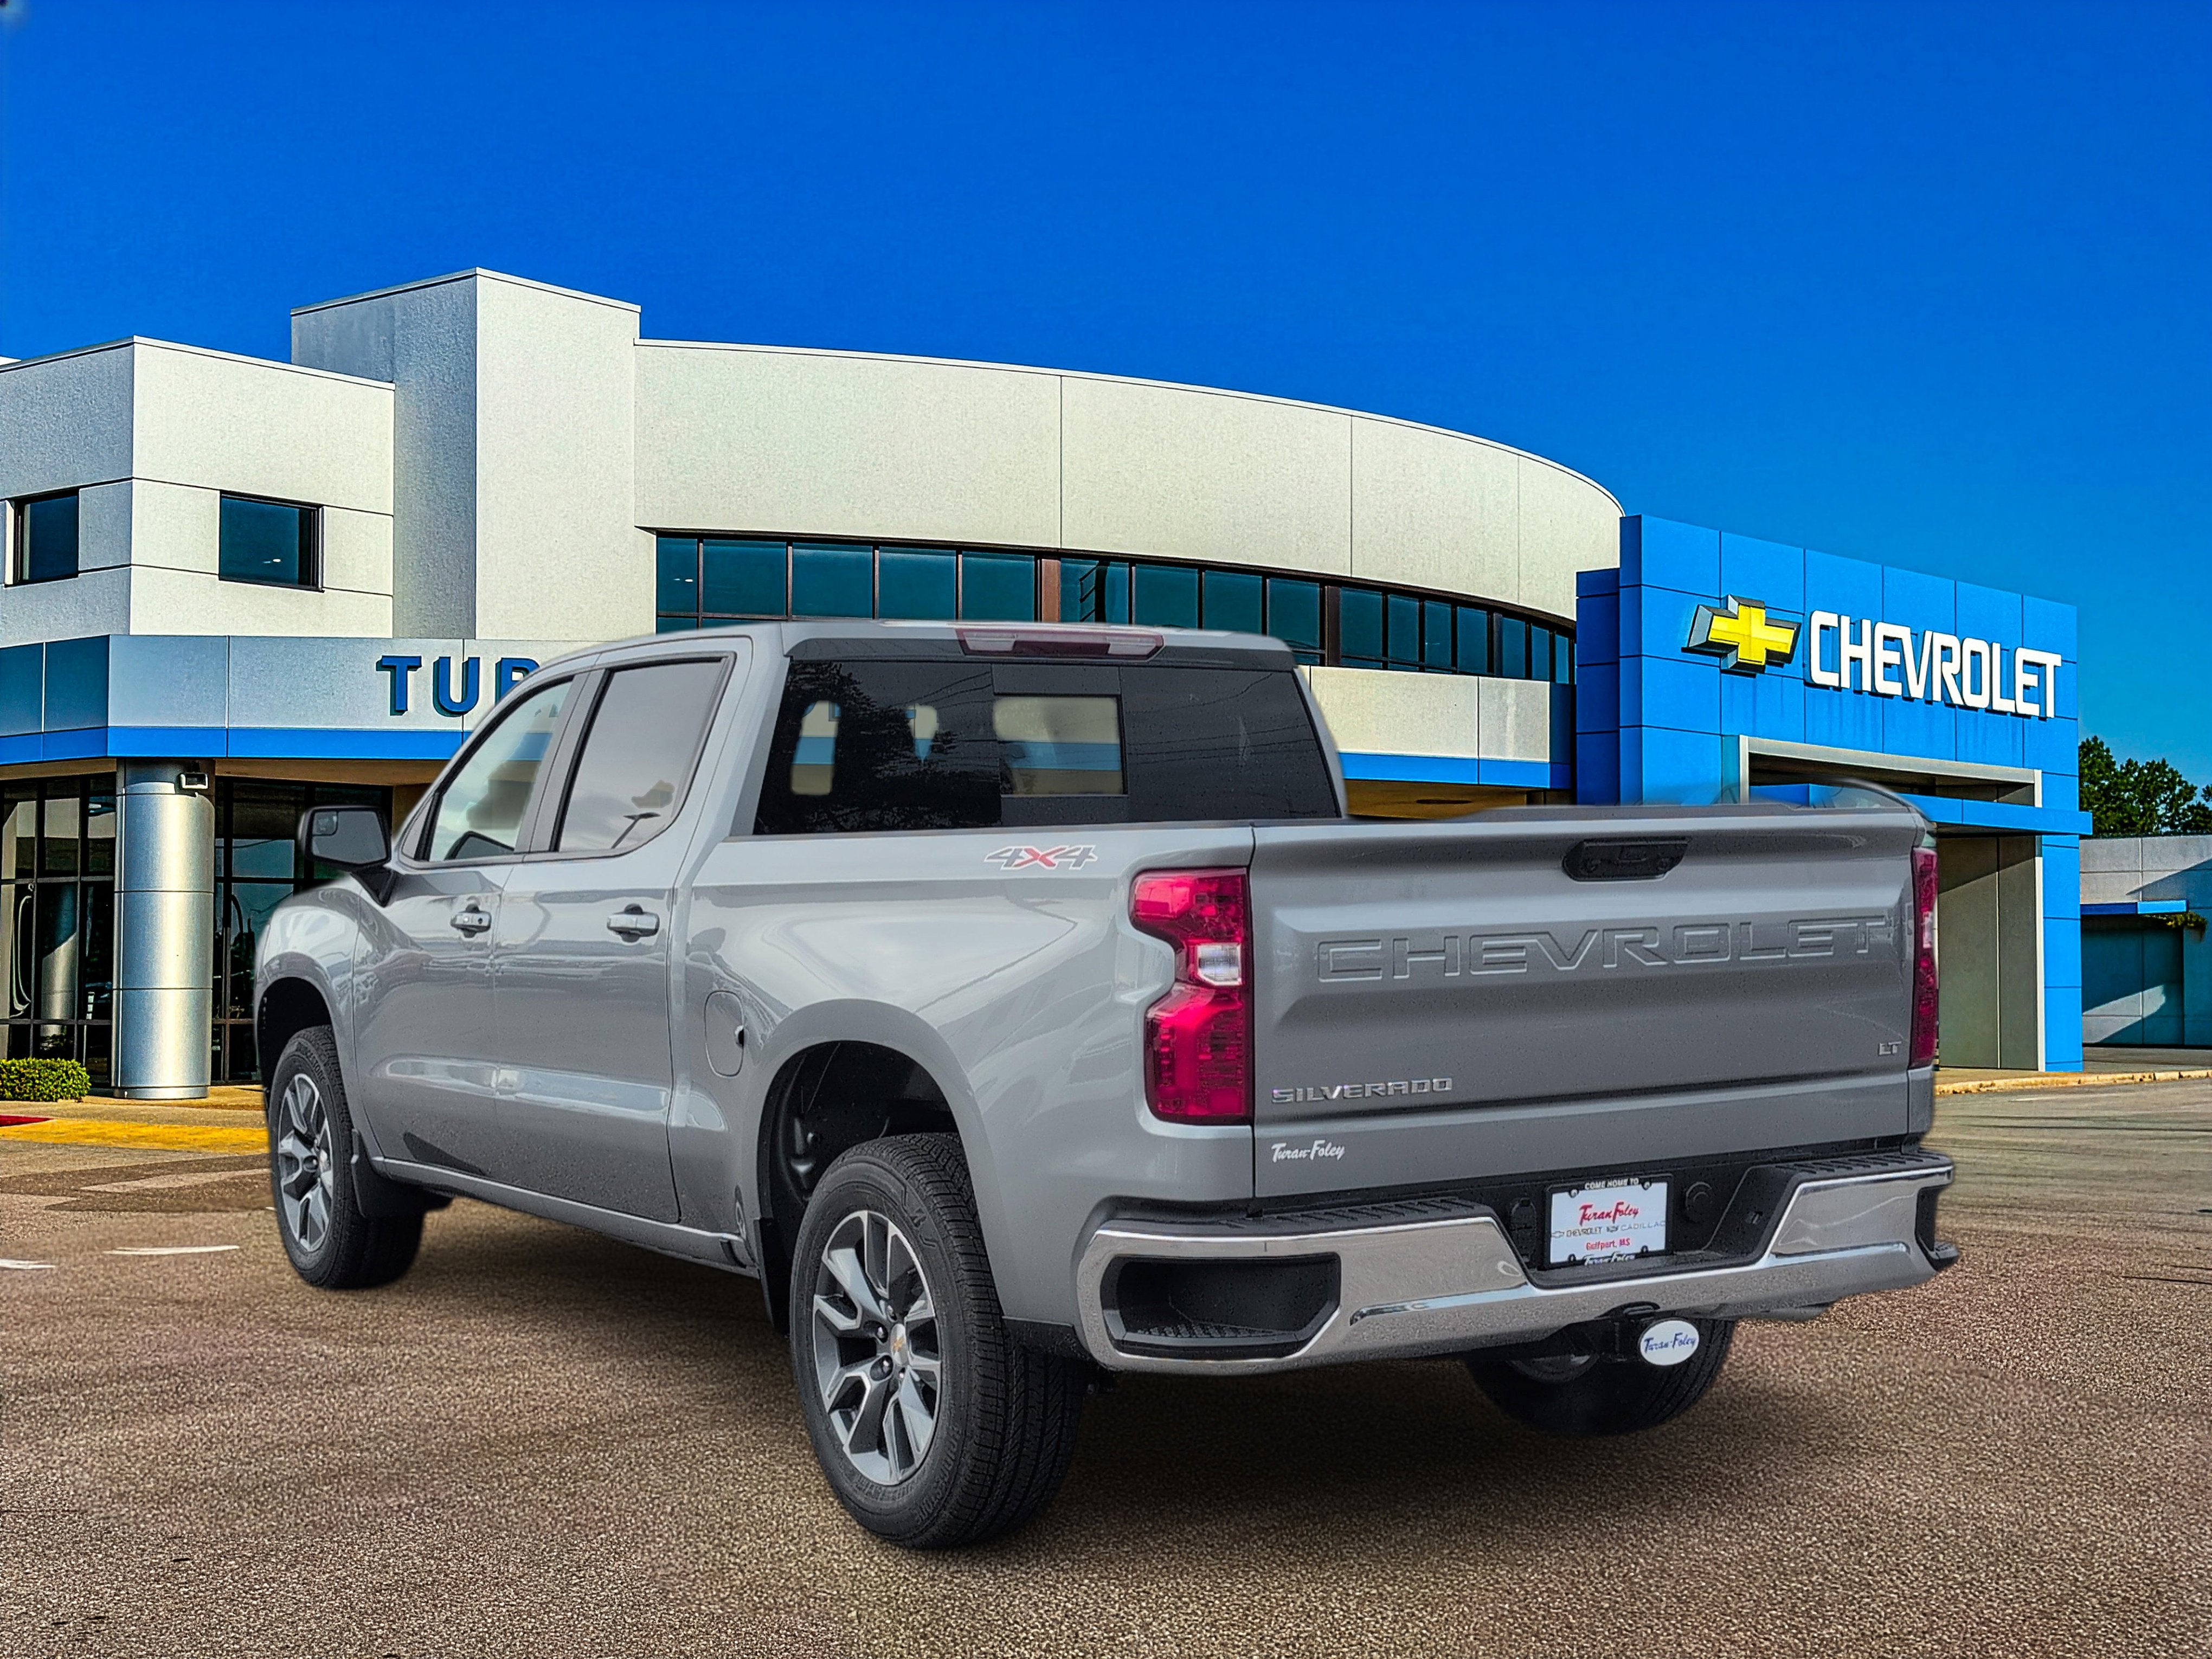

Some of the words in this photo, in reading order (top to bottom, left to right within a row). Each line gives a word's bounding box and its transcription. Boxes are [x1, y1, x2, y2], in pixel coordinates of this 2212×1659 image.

[1810, 609, 2062, 718] CHEVROLET
[1318, 915, 1886, 982] CHEVROLET
[1878, 1041, 1902, 1056] LT
[1272, 1077, 1453, 1103] SILVERADO
[1629, 1177, 1639, 1186] TO
[1621, 1221, 1666, 1231] CADILLAC
